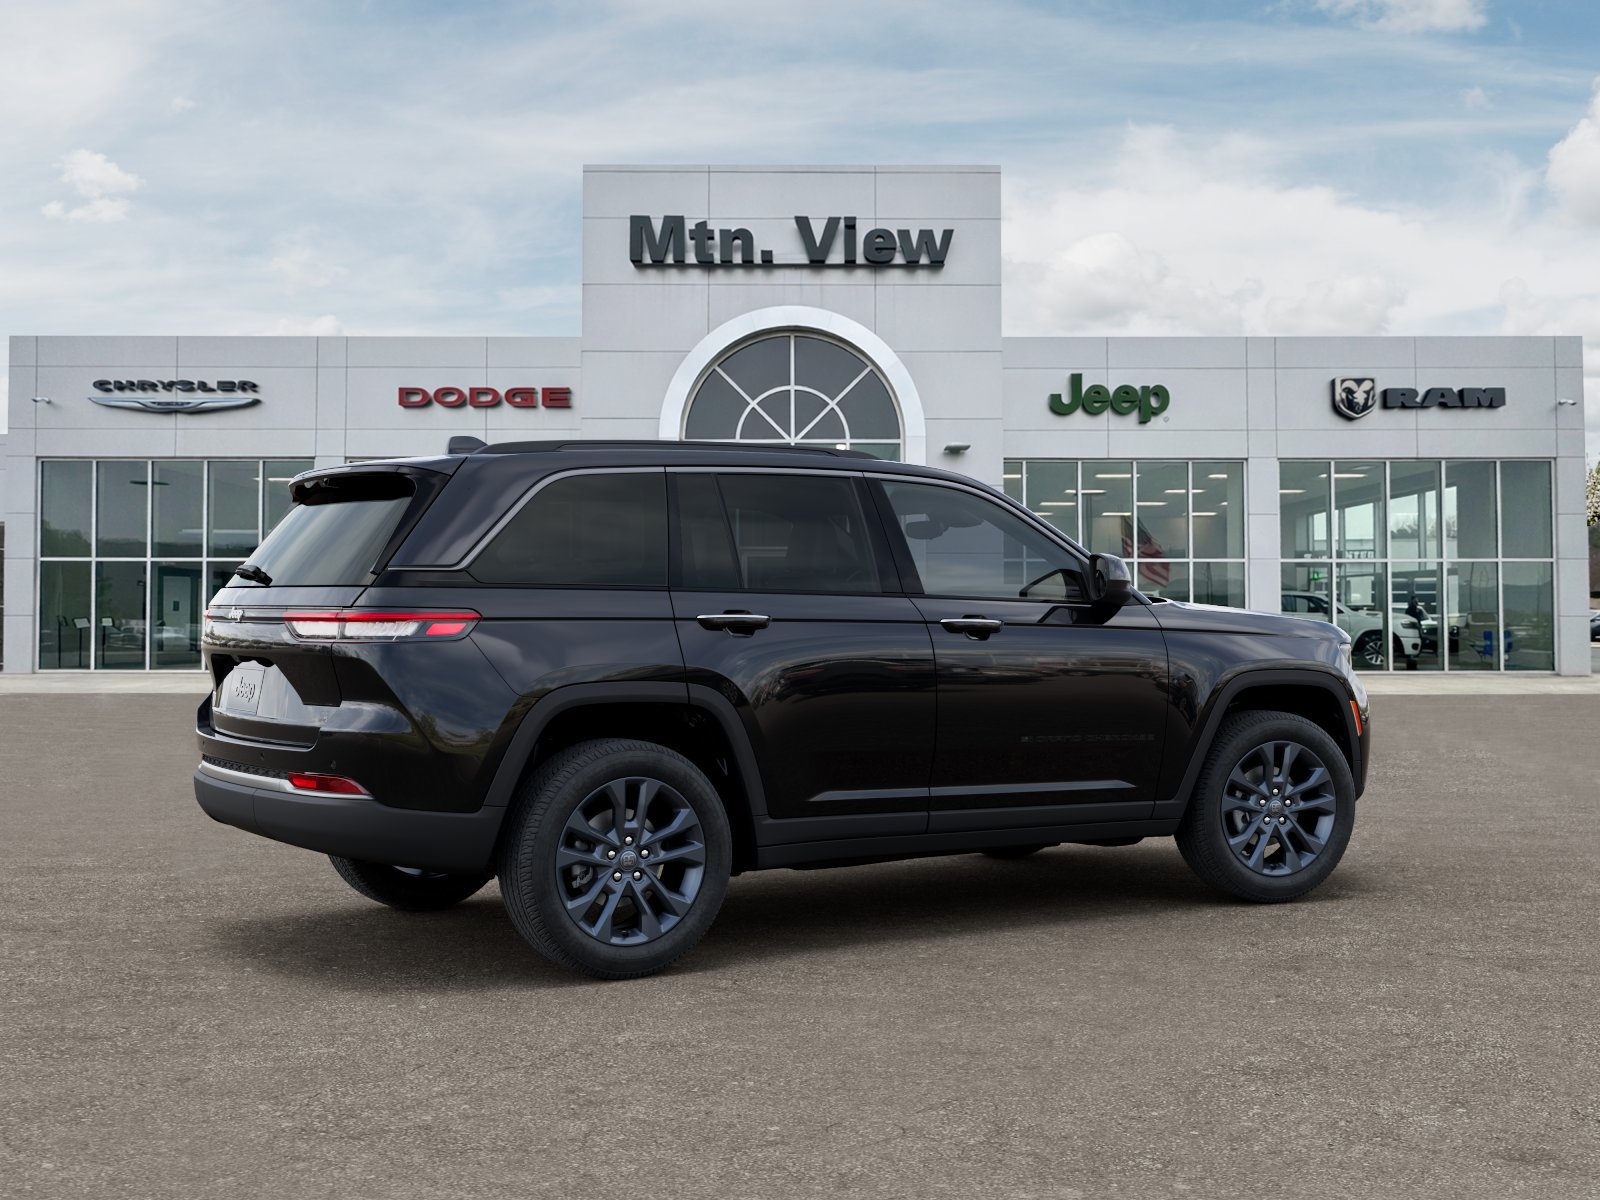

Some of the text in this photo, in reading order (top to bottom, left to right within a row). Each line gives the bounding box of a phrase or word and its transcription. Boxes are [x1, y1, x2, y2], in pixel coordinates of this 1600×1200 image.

[629, 215, 955, 269] Mtn. View
[93, 380, 260, 393] CHRYSLER
[398, 387, 573, 409] DODGE
[1048, 373, 1170, 424] Jeep
[1380, 387, 1506, 410] RAM
